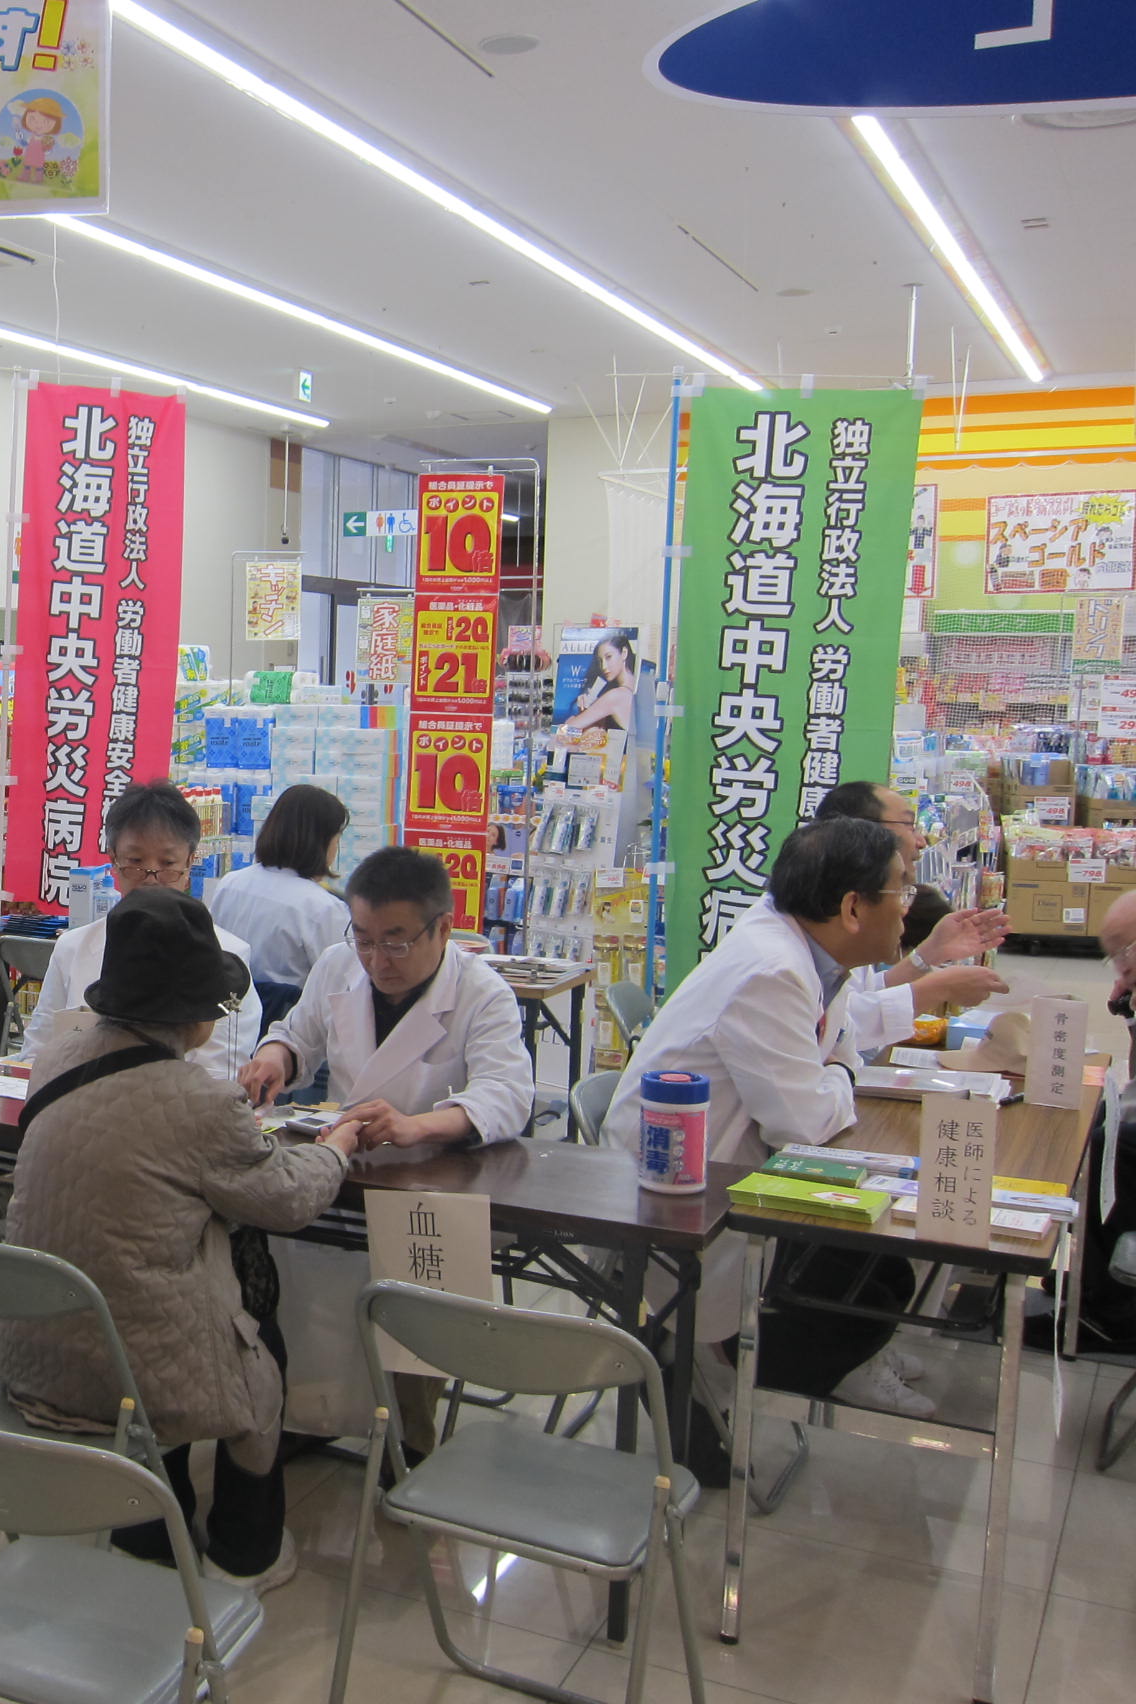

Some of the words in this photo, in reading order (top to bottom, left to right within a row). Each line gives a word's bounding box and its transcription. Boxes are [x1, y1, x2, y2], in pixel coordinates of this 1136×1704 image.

[120, 414, 156, 591] 独立行政法人
[428, 496, 494, 512] ポイント
[812, 417, 873, 635] 独立行政法人
[258, 563, 286, 636] キッチン
[368, 602, 401, 680] 家庭紙
[39, 404, 117, 908] 北海道中央労災病院
[698, 409, 811, 966] 北海道中央労災病
[418, 735, 483, 752] ポイント
[796, 644, 850, 839] 労働者健康
[1051, 1012, 1069, 1096] 骨密度測定
[931, 1119, 961, 1223] 健康相談
[962, 1120, 984, 1227] 医師による
